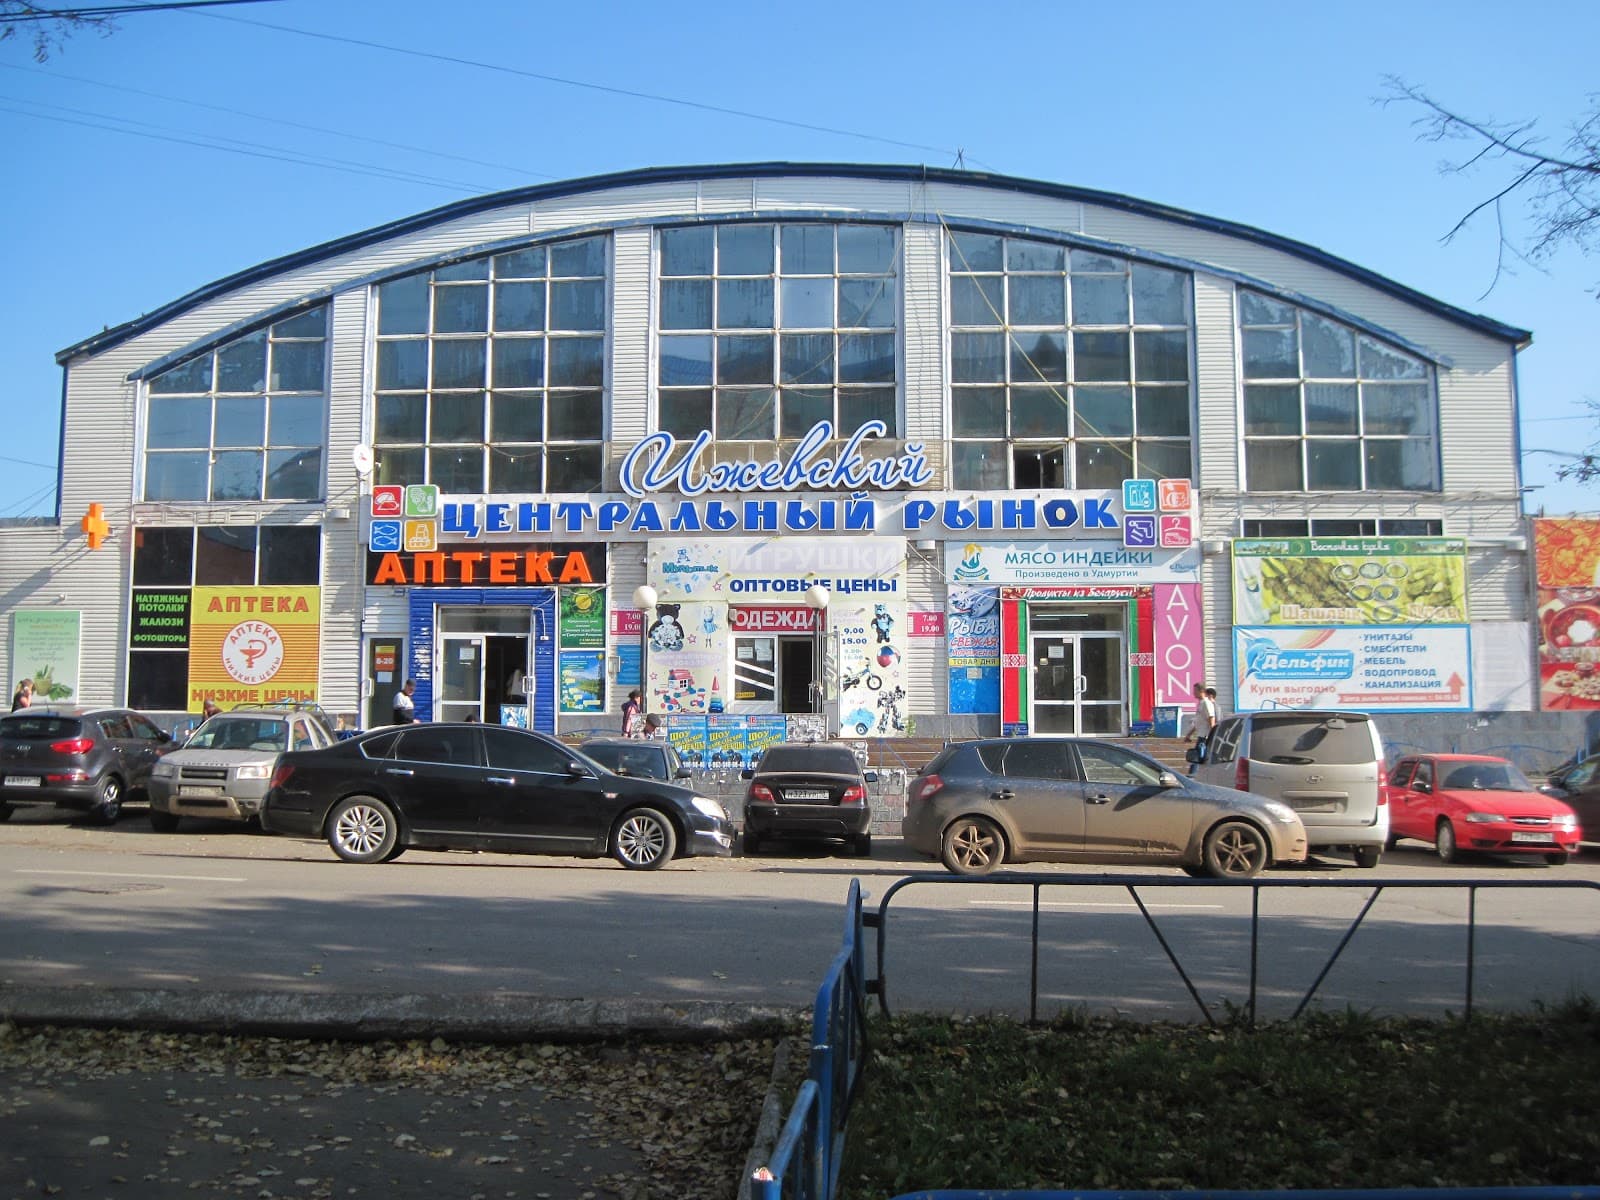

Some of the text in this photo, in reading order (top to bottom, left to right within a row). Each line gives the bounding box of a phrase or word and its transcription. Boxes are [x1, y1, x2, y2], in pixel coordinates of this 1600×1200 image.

[620, 420, 934, 499] Ижевский
[440, 492, 1121, 537] ЦЕНТРАЛЬНЫЙ РЫНОК
[729, 543, 897, 571] ИГРУШКИ
[1005, 548, 1153, 566] МЯСО ИНДЕЙКИ
[373, 551, 593, 584] АПТЕКА
[1015, 569, 1139, 579] Произведено в Удмуртии
[729, 578, 897, 594] ОПТОВЫЕ ЦЕНЫ
[1023, 588, 1070, 600] Продукты
[138, 603, 185, 612] ПОТОЛКИ
[207, 596, 309, 613] АПТЕКА
[139, 617, 184, 627] ЖАЛЮЗИ
[949, 616, 997, 636] РЫБА
[230, 623, 278, 646] АПТЕКА
[843, 627, 864, 635] 9.00
[1363, 633, 1413, 641] УНИТАЗЫ
[134, 634, 187, 642] ФОТОШТОРЫ
[842, 637, 868, 645] 18.00
[950, 637, 998, 647] СВЕЖАЯ
[1165, 583, 1192, 697] AVON
[1364, 645, 1427, 653] СМЕСИТЕЛИ
[1261, 654, 1349, 672] Дельфин
[1363, 657, 1406, 665] МЕБЕЛЬ
[225, 656, 281, 683] НИЗКИЕ ЦЕНЫ
[1364, 669, 1437, 678] ВОДОПРОВОД
[1250, 684, 1337, 696] Купи выгодно
[1365, 681, 1442, 689] КАНАЛИЗАЦИЯ
[191, 689, 315, 702] НИЗКИЕ ЦЕНЫ
